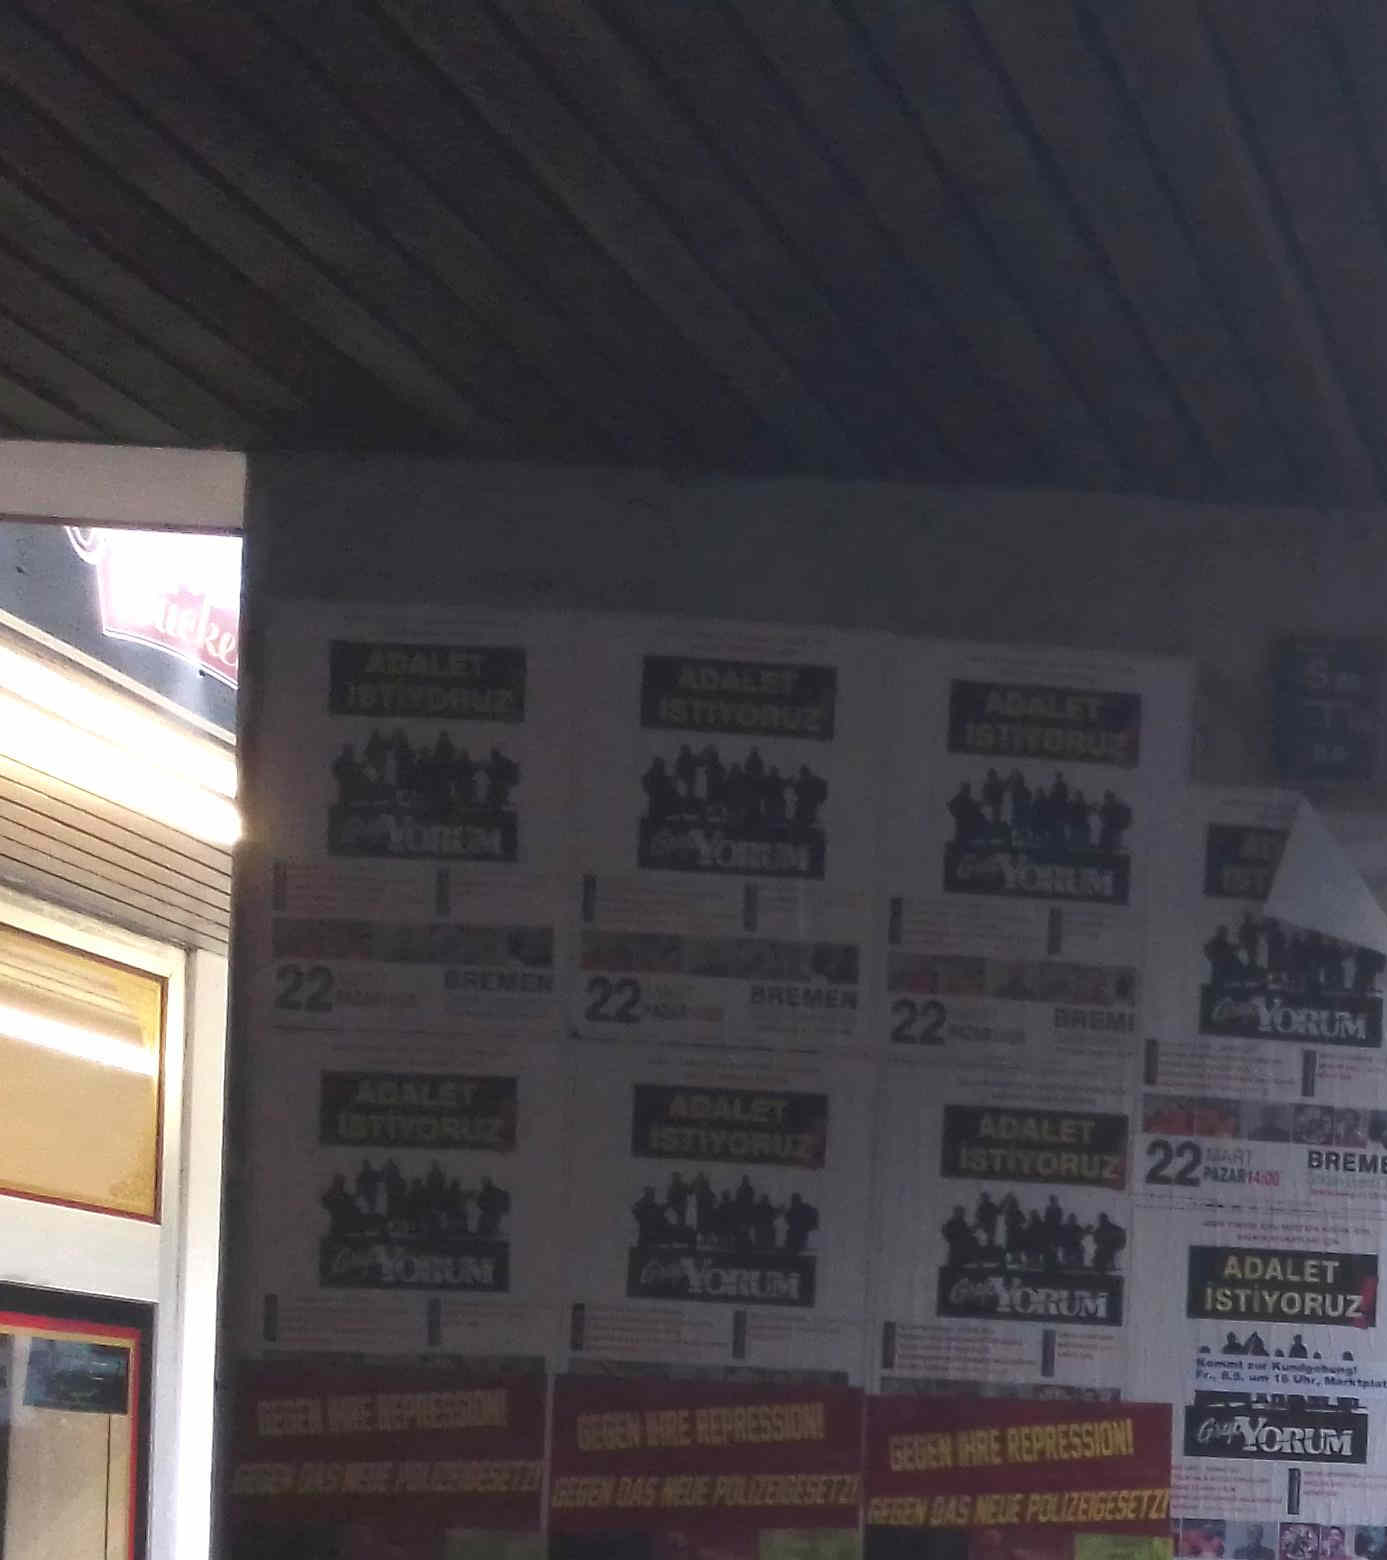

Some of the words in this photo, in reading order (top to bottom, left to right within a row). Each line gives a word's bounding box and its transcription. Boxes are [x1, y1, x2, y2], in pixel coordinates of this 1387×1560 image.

[275, 964, 334, 1012] 22
[585, 975, 641, 1024] 22
[890, 998, 946, 1045] 22
[1253, 995, 1366, 1039] YORUM
[669, 1095, 786, 1122] ADALET
[979, 1114, 1095, 1144] ADALET
[1145, 1140, 1200, 1187] 22
[1223, 1255, 1340, 1283] ADALET
[1235, 1416, 1353, 1456] YORUM
